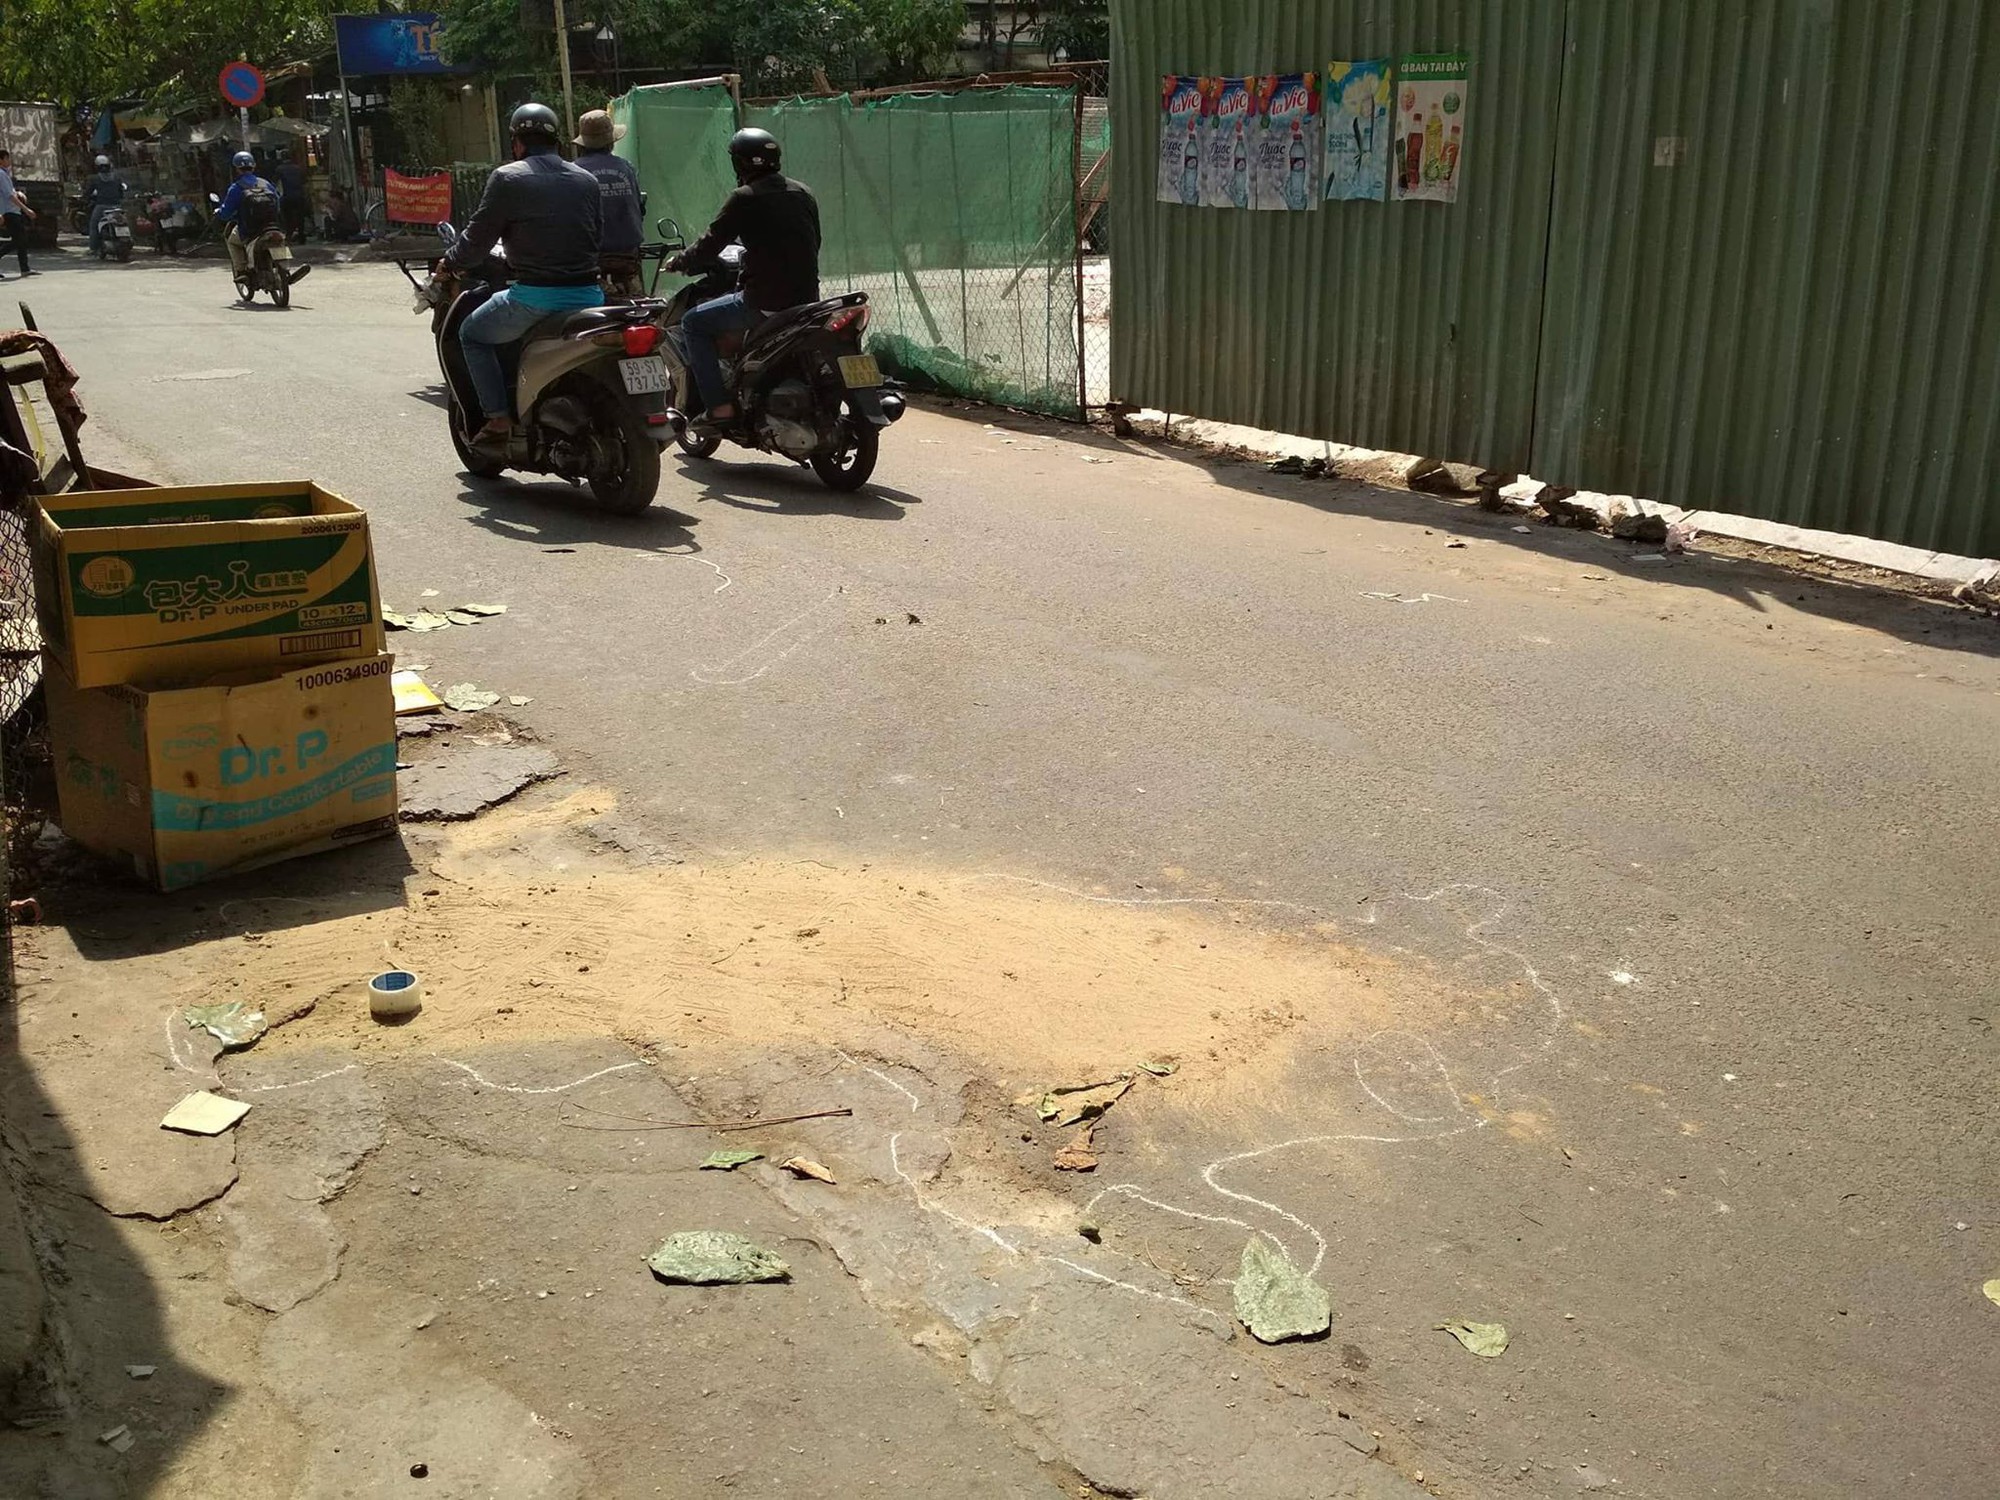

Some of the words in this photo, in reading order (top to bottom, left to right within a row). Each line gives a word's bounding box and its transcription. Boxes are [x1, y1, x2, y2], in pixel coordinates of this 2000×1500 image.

[224, 603, 270, 616] UNDER
[272, 600, 299, 611] PAD
[296, 660, 389, 692] 1000634900
[267, 752, 384, 812] Comfortable
